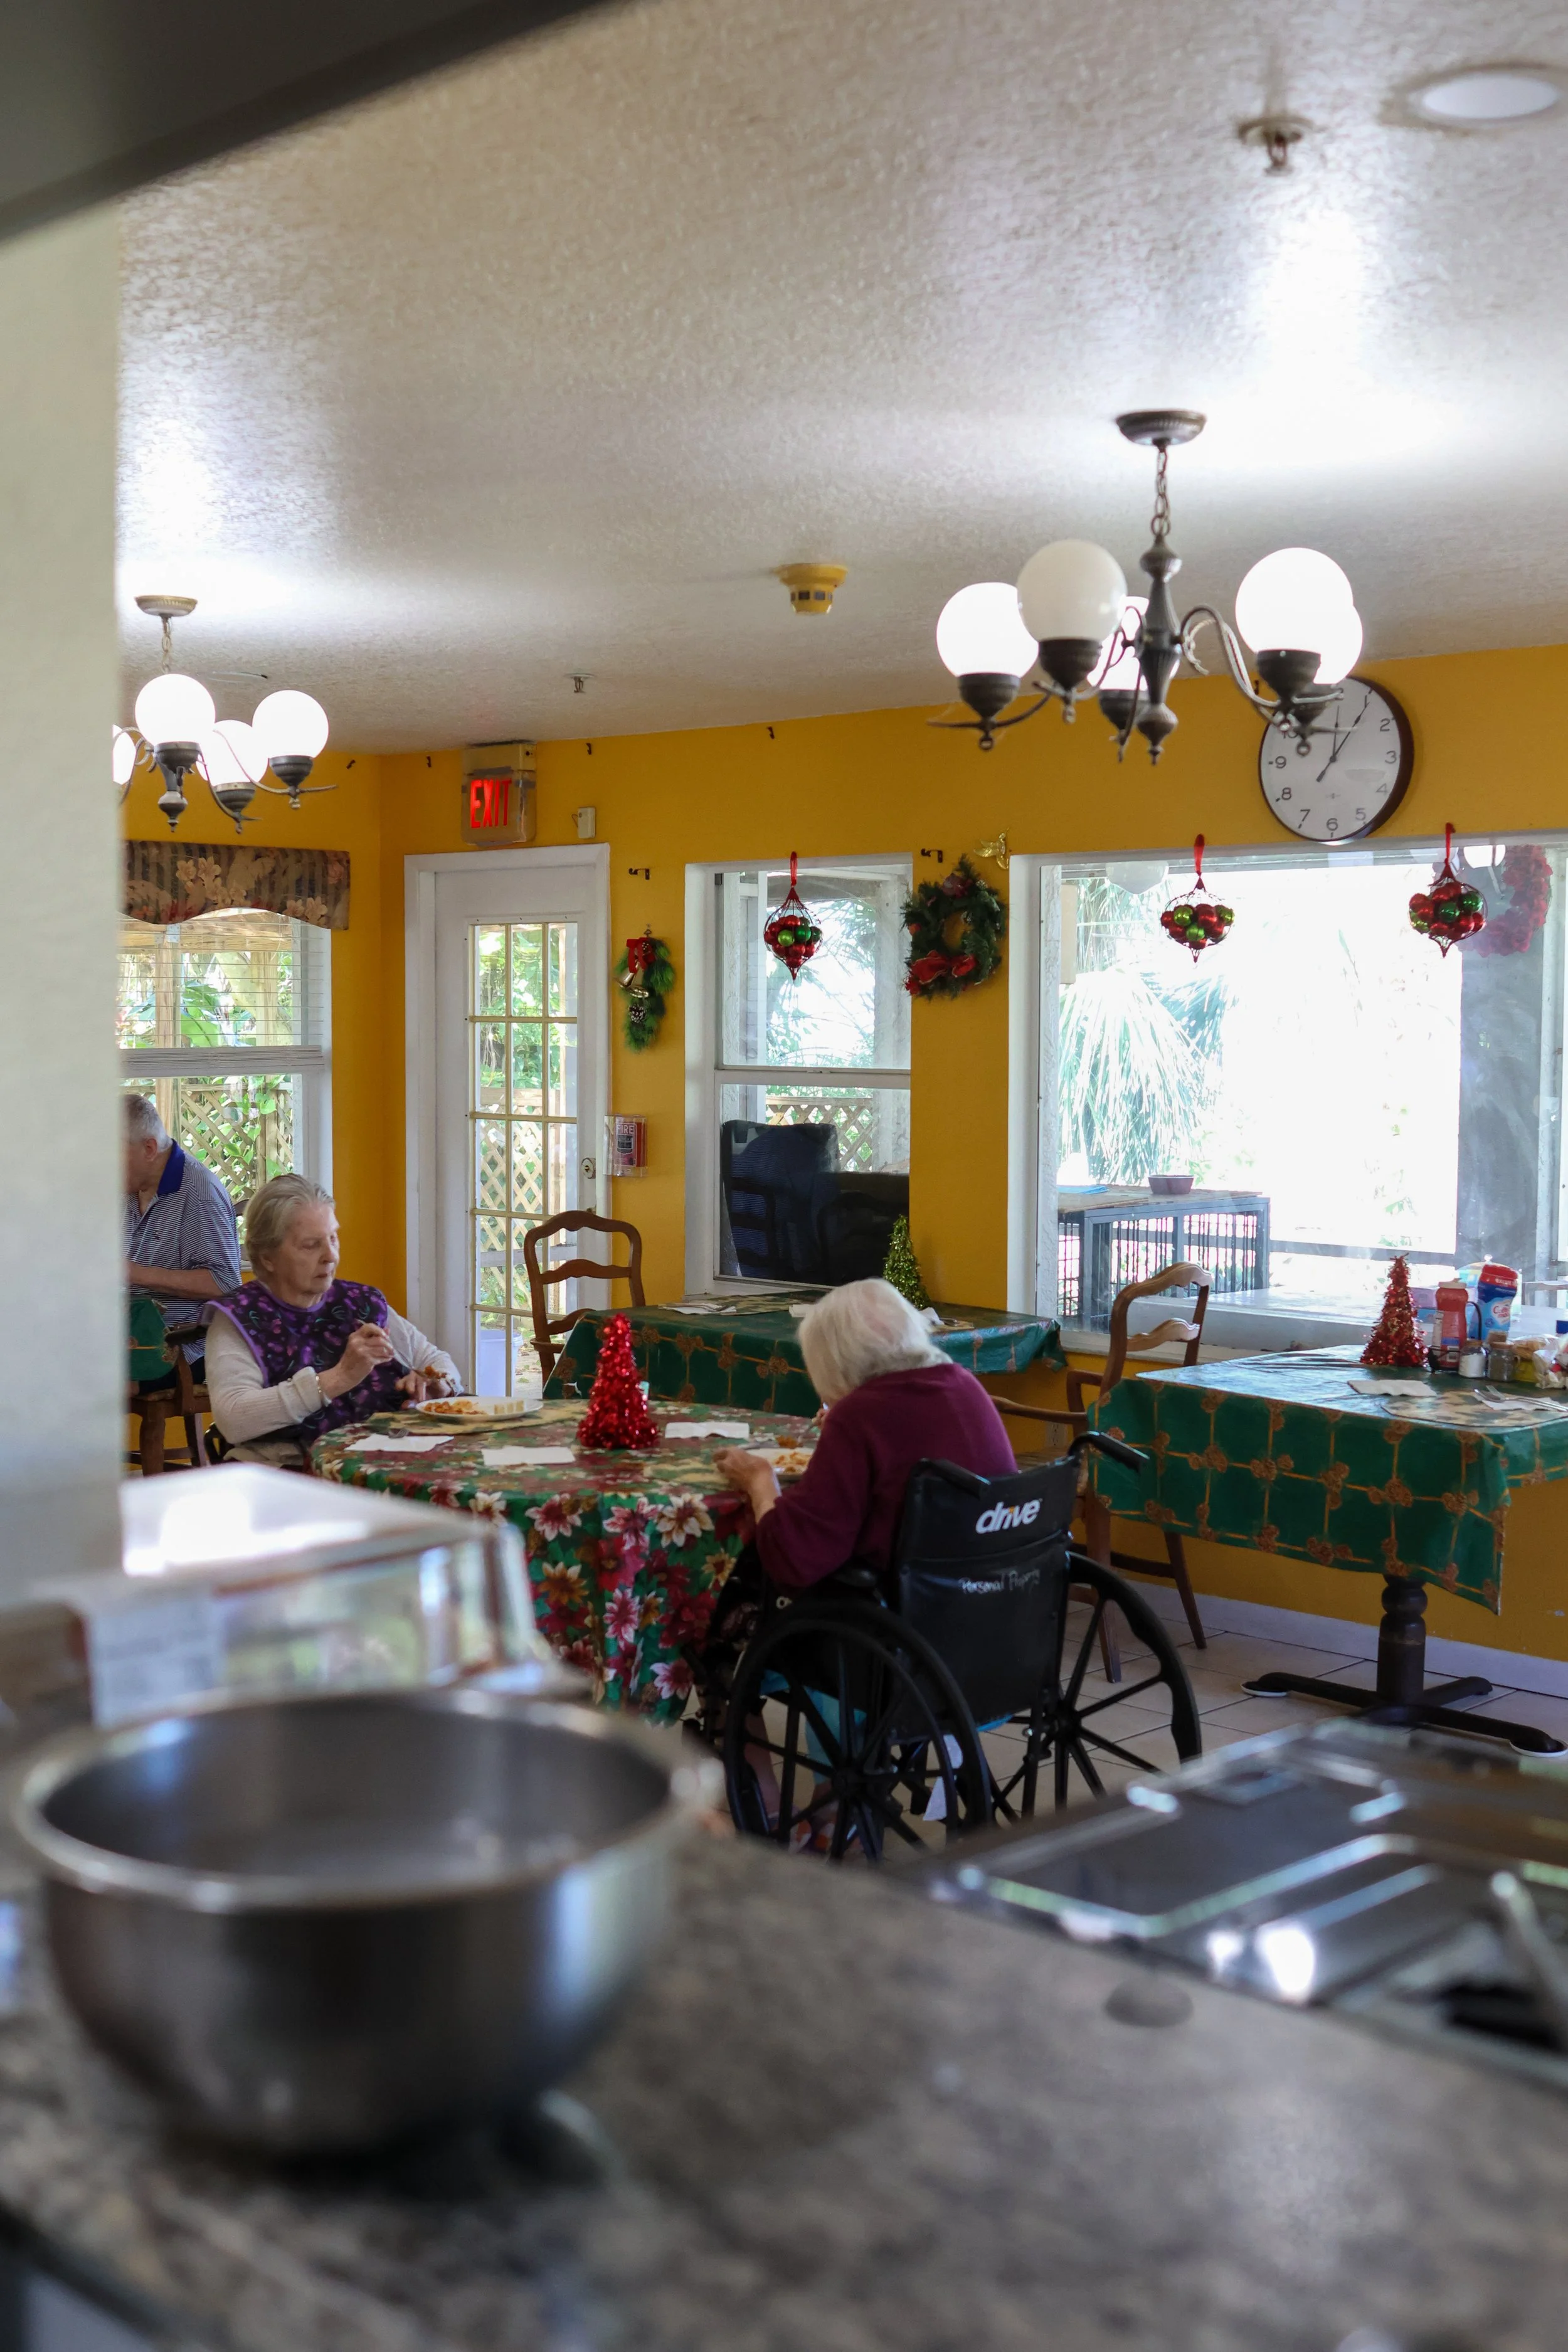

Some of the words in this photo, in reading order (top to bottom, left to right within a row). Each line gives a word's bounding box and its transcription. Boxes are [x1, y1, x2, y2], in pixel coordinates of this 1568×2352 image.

[1379, 718, 1391, 732] 2
[1274, 756, 1287, 769] 9
[1384, 751, 1397, 764] 3
[1281, 787, 1292, 801] 8
[1375, 783, 1388, 796] 4
[470, 778, 512, 829] EXIT
[1300, 808, 1311, 822] 7
[1355, 807, 1367, 821] 5
[1326, 817, 1338, 832] 6
[617, 1124, 633, 1135] FIRE
[975, 1498, 1041, 1535] drive
